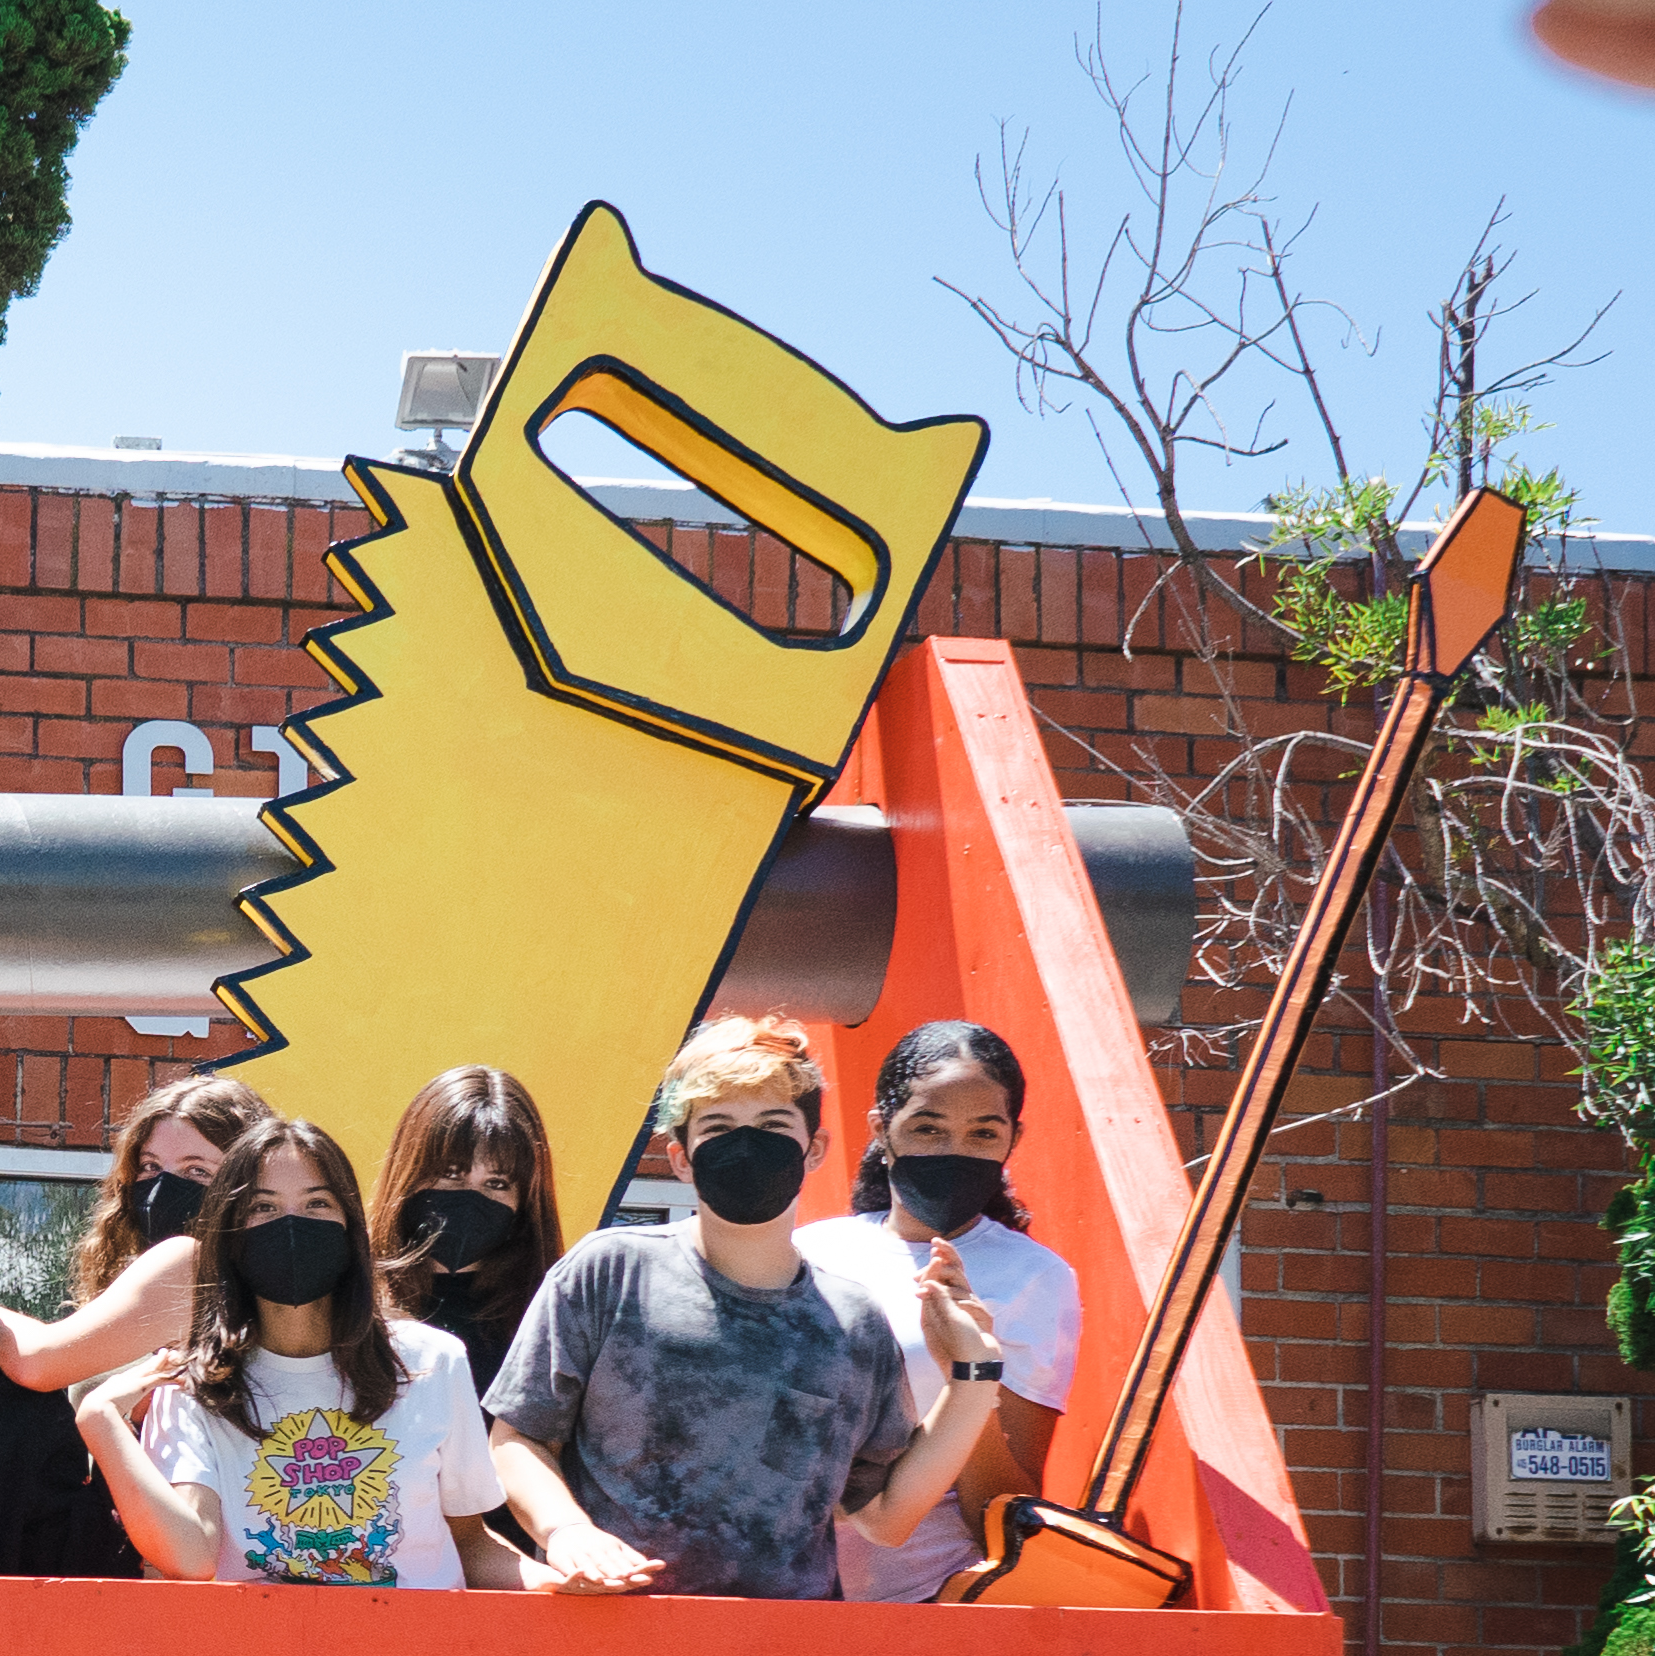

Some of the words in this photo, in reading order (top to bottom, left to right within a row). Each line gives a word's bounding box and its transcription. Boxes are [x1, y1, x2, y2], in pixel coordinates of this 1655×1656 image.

[292, 1435, 348, 1462] POP
[1516, 1439, 1563, 1452] BURGLAR
[1568, 1441, 1605, 1453] ALARM
[280, 1456, 362, 1487] SHOP
[1528, 1454, 1606, 1477] 548-0515
[289, 1484, 356, 1498] TOKYO
